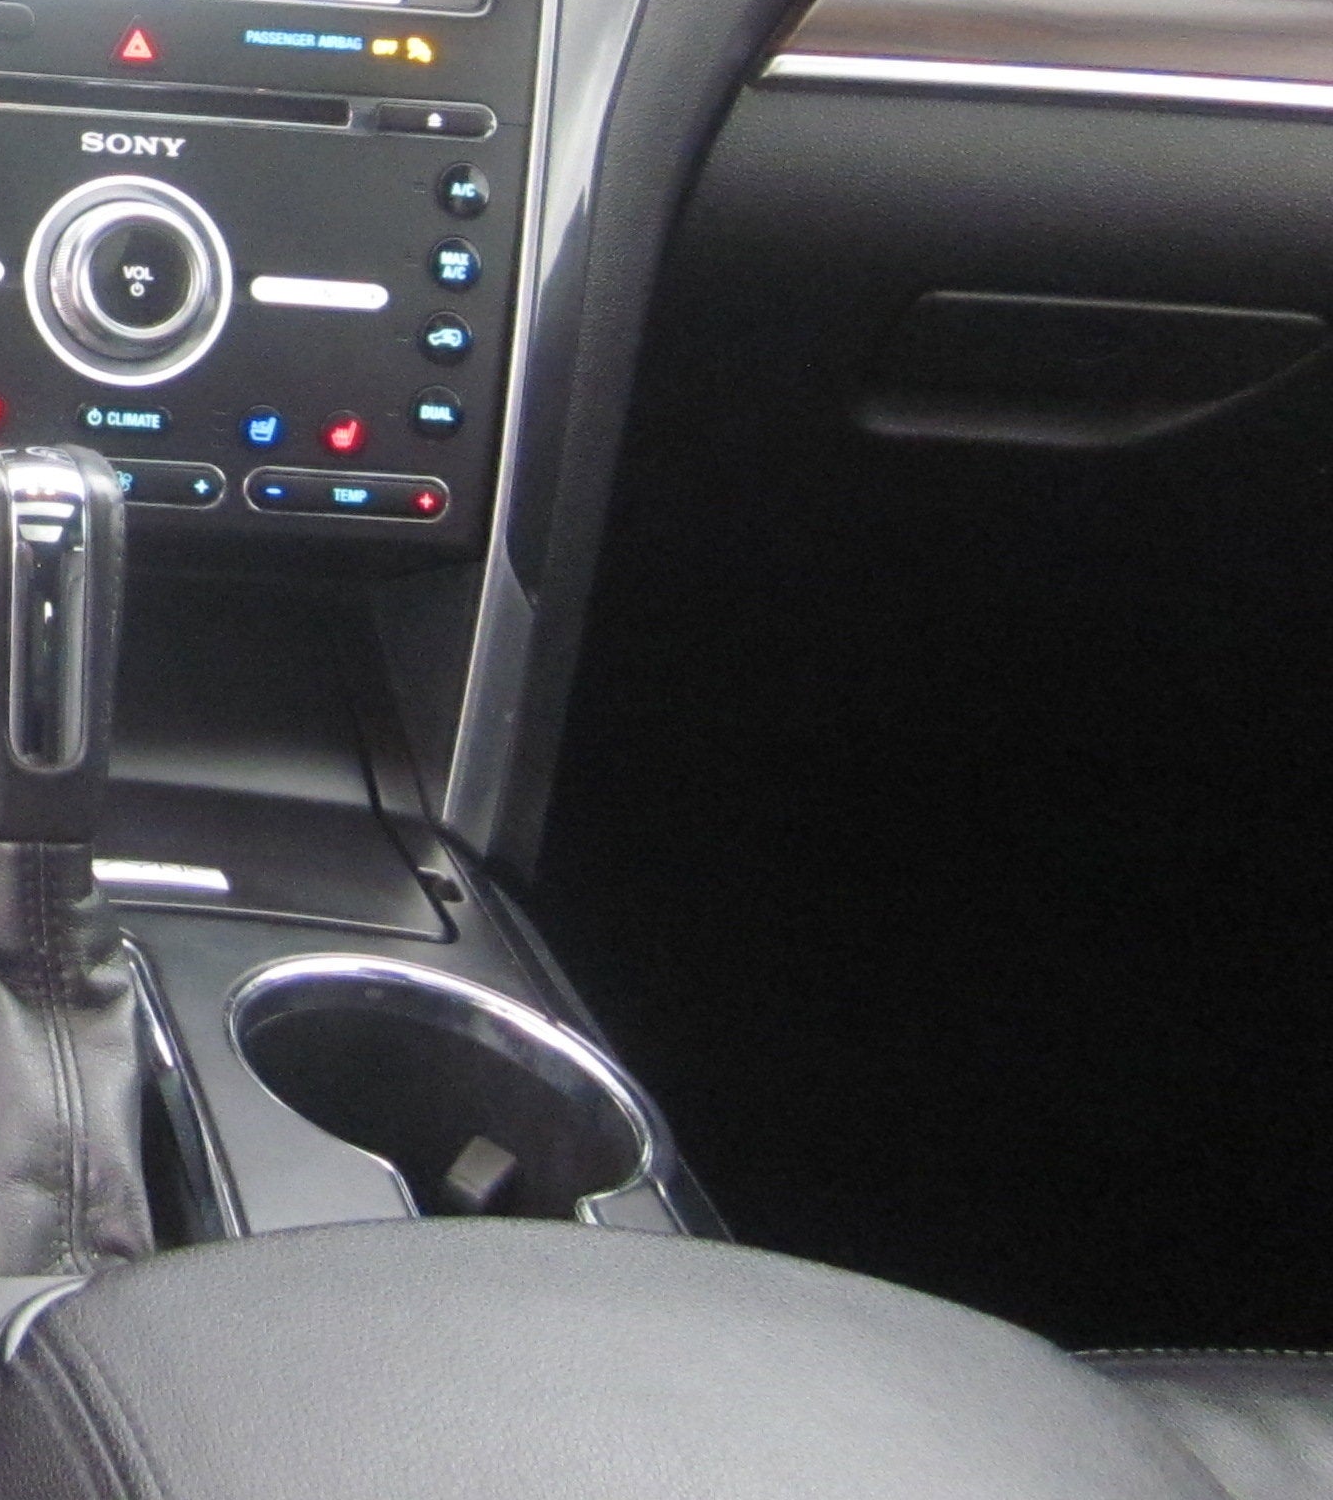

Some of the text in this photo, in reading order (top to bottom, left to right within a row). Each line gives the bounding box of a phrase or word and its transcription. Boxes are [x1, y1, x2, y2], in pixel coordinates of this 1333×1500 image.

[245, 29, 316, 48] PASSENGER
[317, 34, 364, 51] AIRBAG
[80, 130, 187, 158] SONY
[451, 182, 477, 198] A/C
[439, 251, 470, 266] MAX
[122, 264, 154, 282] VOL
[442, 266, 467, 281] A/C
[106, 411, 161, 430] CLIMATE
[419, 404, 454, 422] DUAL
[332, 486, 369, 504] TEMP
